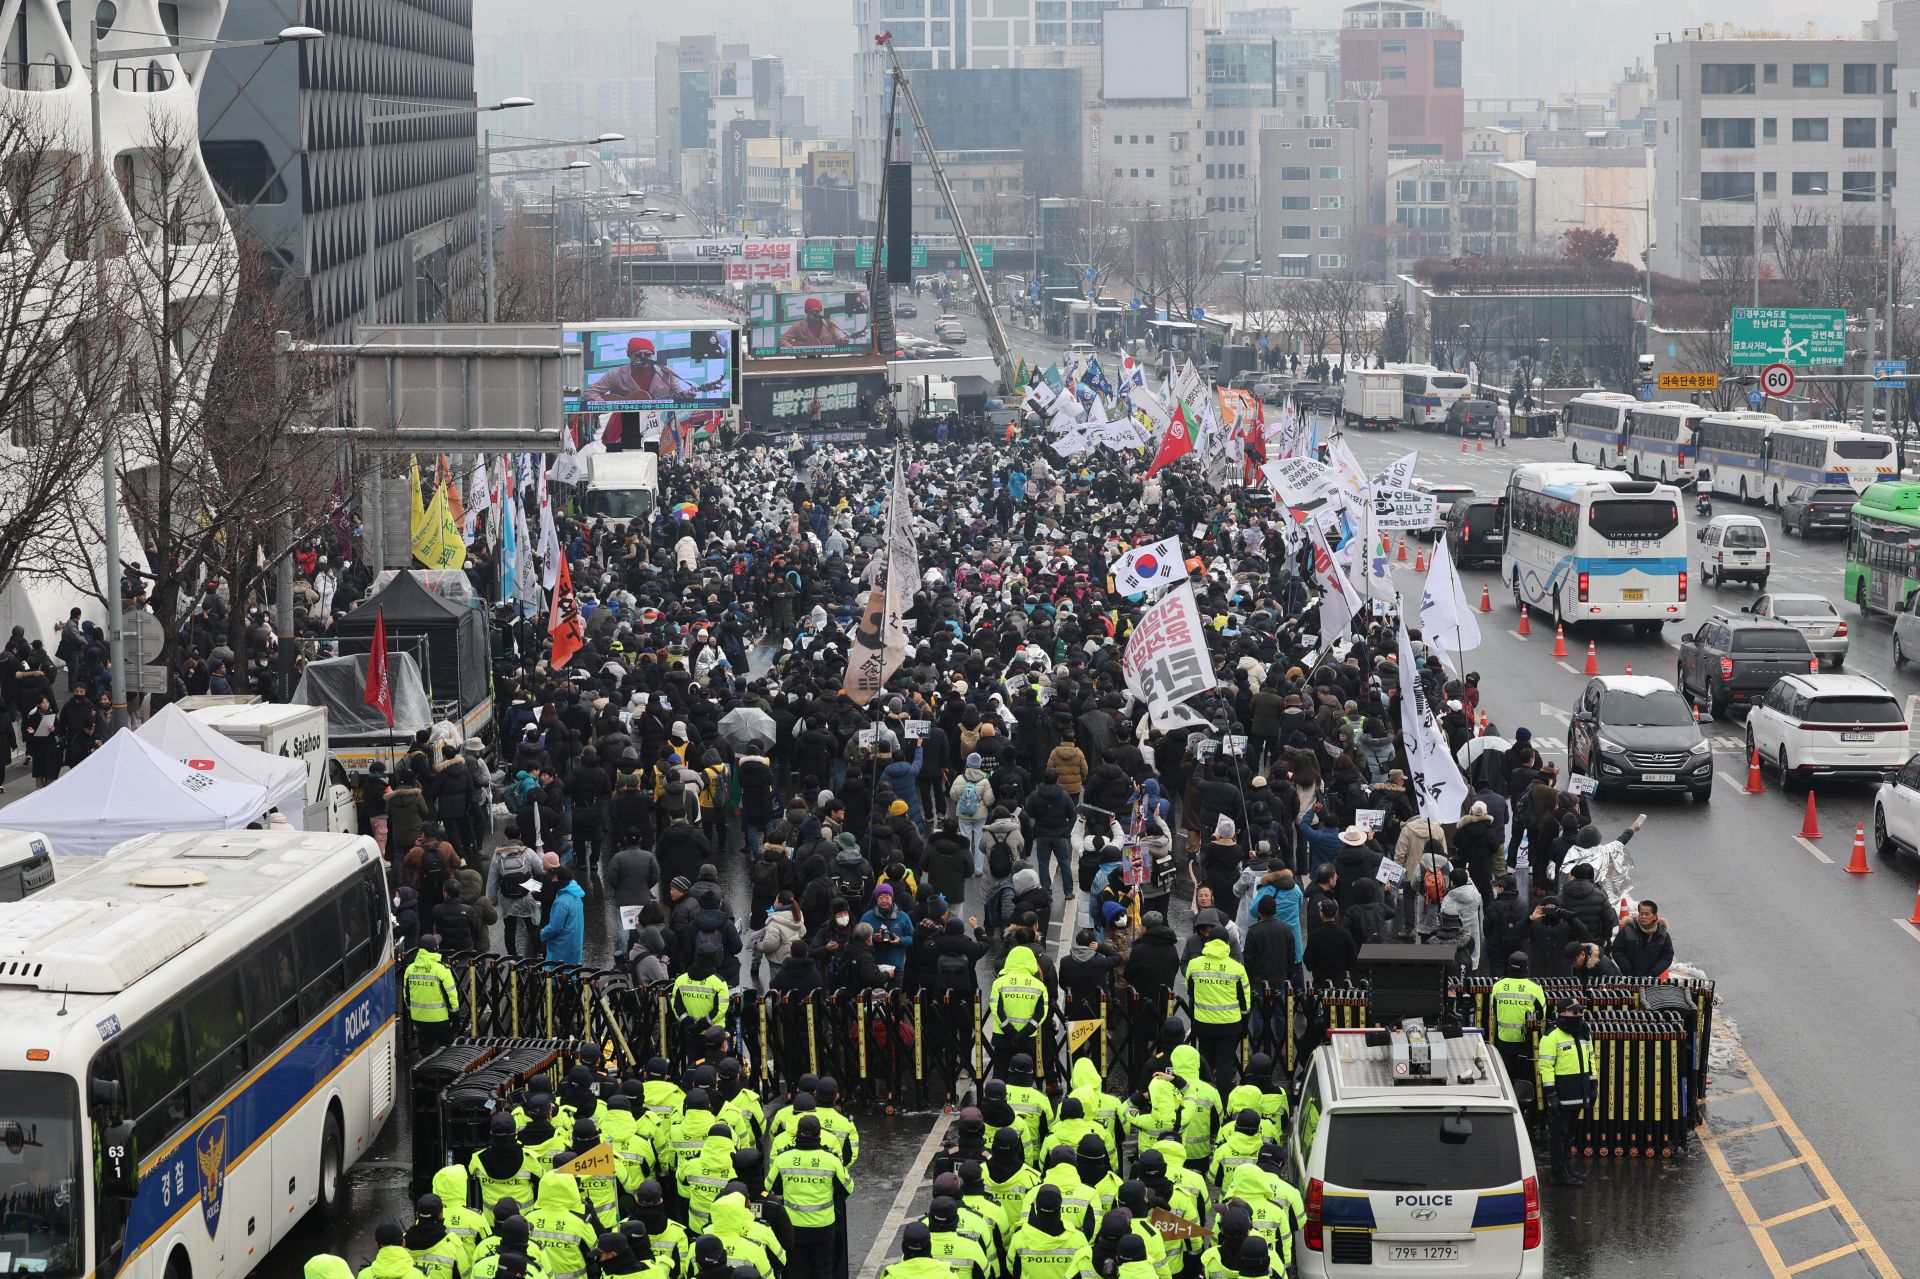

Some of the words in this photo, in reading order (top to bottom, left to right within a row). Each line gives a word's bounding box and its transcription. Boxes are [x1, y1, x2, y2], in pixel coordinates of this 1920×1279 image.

[733, 145, 741, 178] Helinox
[696, 242, 742, 258] 내란수괴
[745, 243, 791, 260] 윤석열
[1746, 310, 1787, 319] 경부고속도로
[1752, 319, 1787, 329] 한남대교
[1811, 331, 1844, 340] 강변북로
[1733, 341, 1767, 350] 금호사거리
[1662, 376, 1715, 387] 과속단속장비
[1768, 373, 1787, 387] 60
[773, 387, 815, 403] 내란수괴
[772, 402, 799, 418] 즉각
[1415, 503, 1432, 514] 노조
[293, 733, 321, 758] Sajahoo
[1199, 978, 1231, 986] POLICE
[681, 992, 711, 1001] POLICE
[1004, 993, 1036, 1001] POLICE
[345, 999, 371, 1045] POLICE
[574, 1154, 609, 1172] 54기-1
[162, 1160, 184, 1208] 경찰
[787, 1175, 826, 1184] POLICE
[1396, 1195, 1453, 1206] POLICE
[206, 1202, 220, 1222] POLICE
[1396, 1247, 1417, 1258] 79두
[1424, 1247, 1452, 1258] 1279
[1028, 1256, 1073, 1264] POLICE
